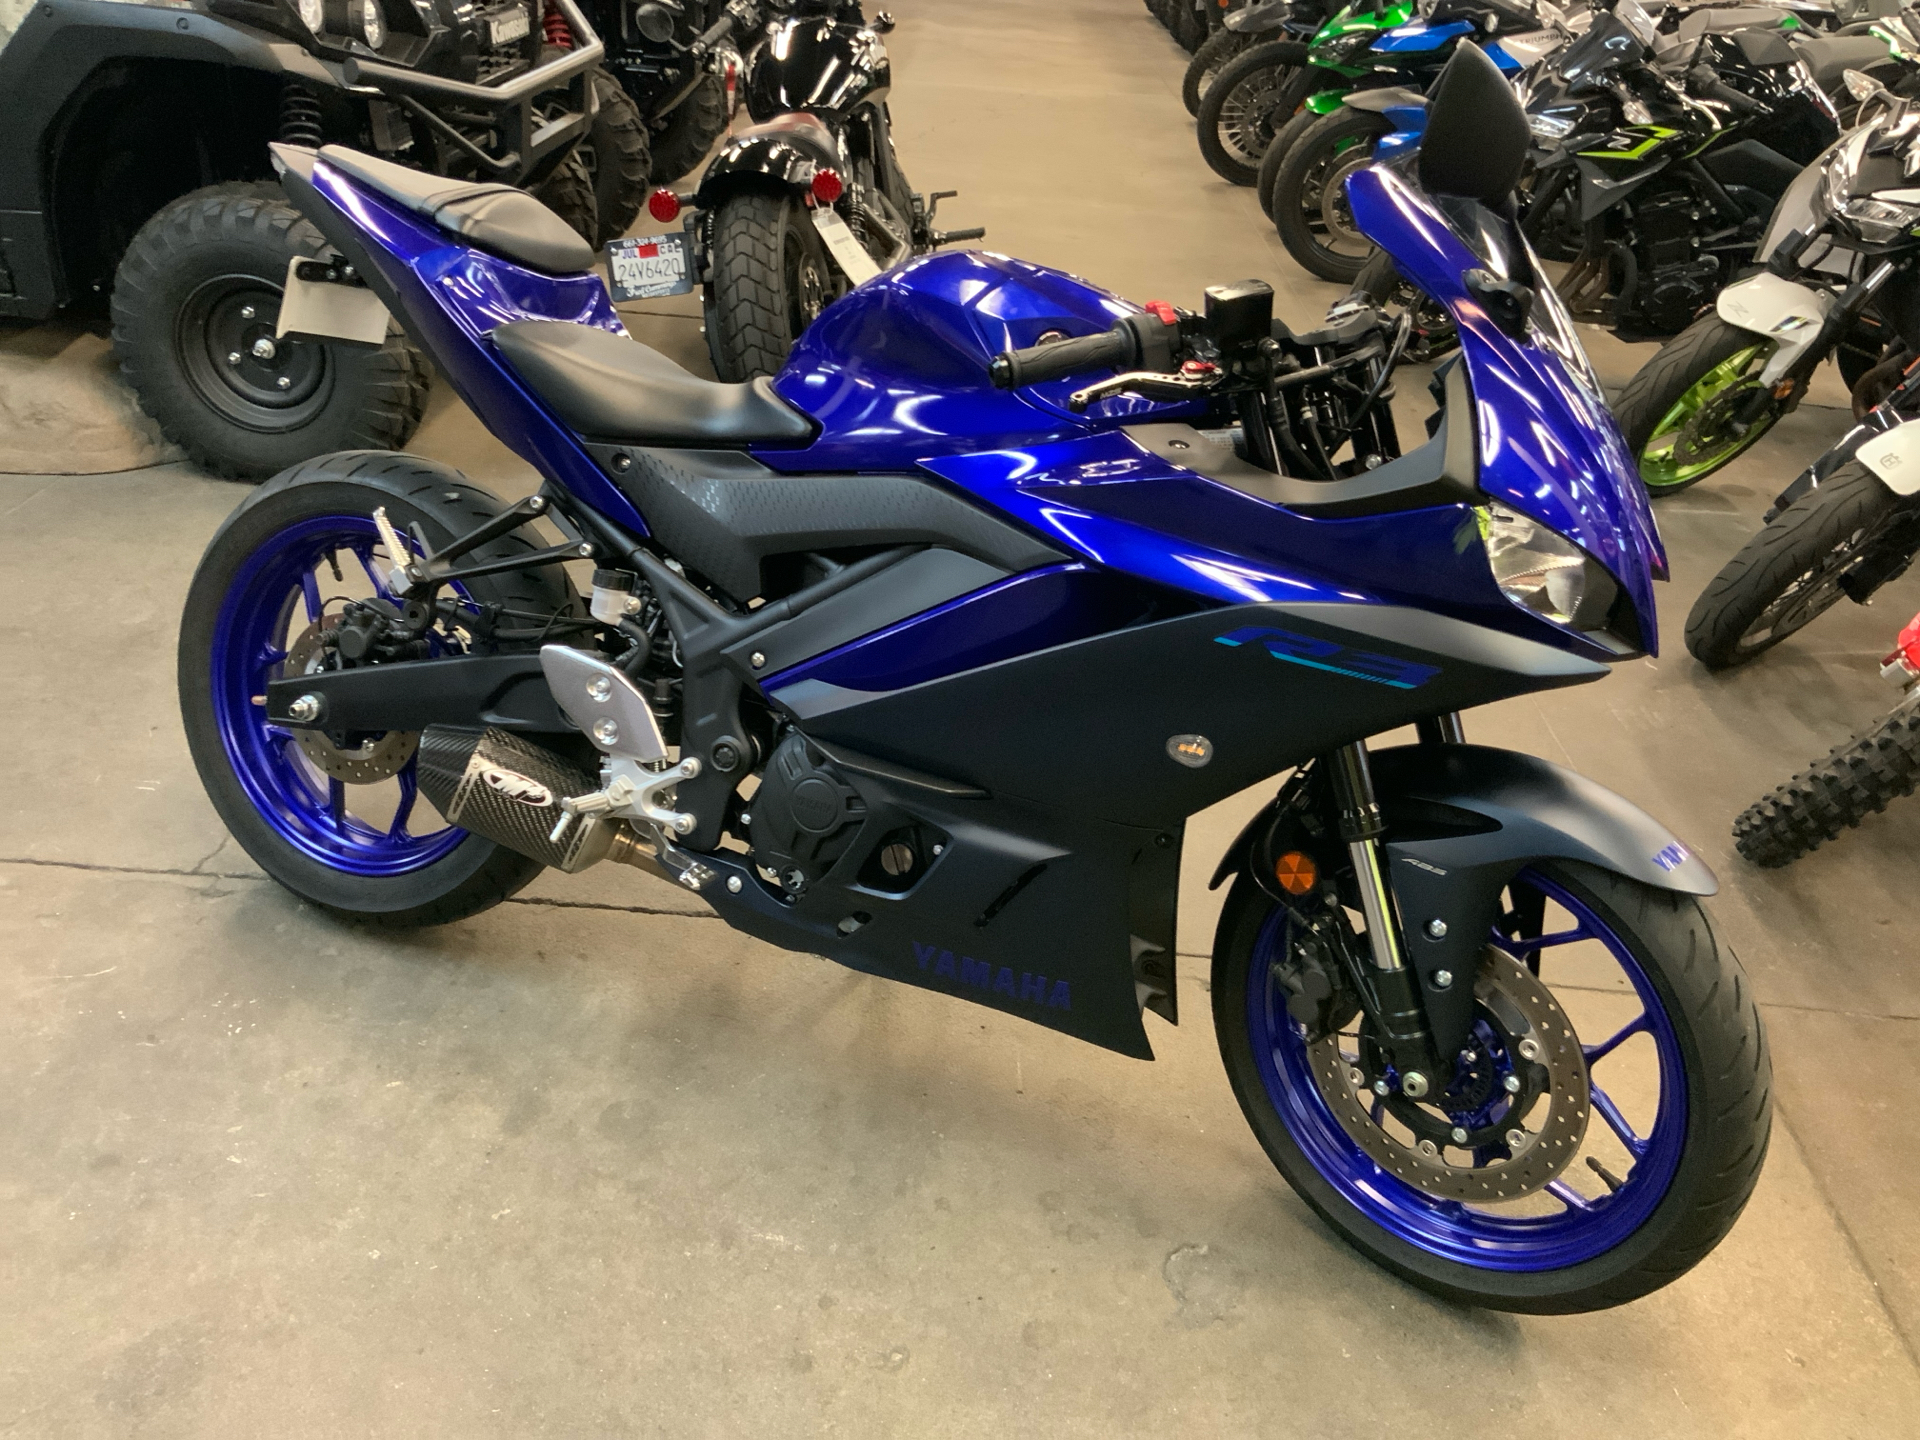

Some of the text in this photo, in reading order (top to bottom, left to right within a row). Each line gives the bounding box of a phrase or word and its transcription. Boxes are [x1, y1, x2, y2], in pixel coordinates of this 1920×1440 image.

[1519, 33, 1562, 45] TRIUMPH
[622, 244, 681, 260] JUL CAL
[618, 257, 682, 282] 24V6420
[912, 940, 1072, 1011] YAMAHA
